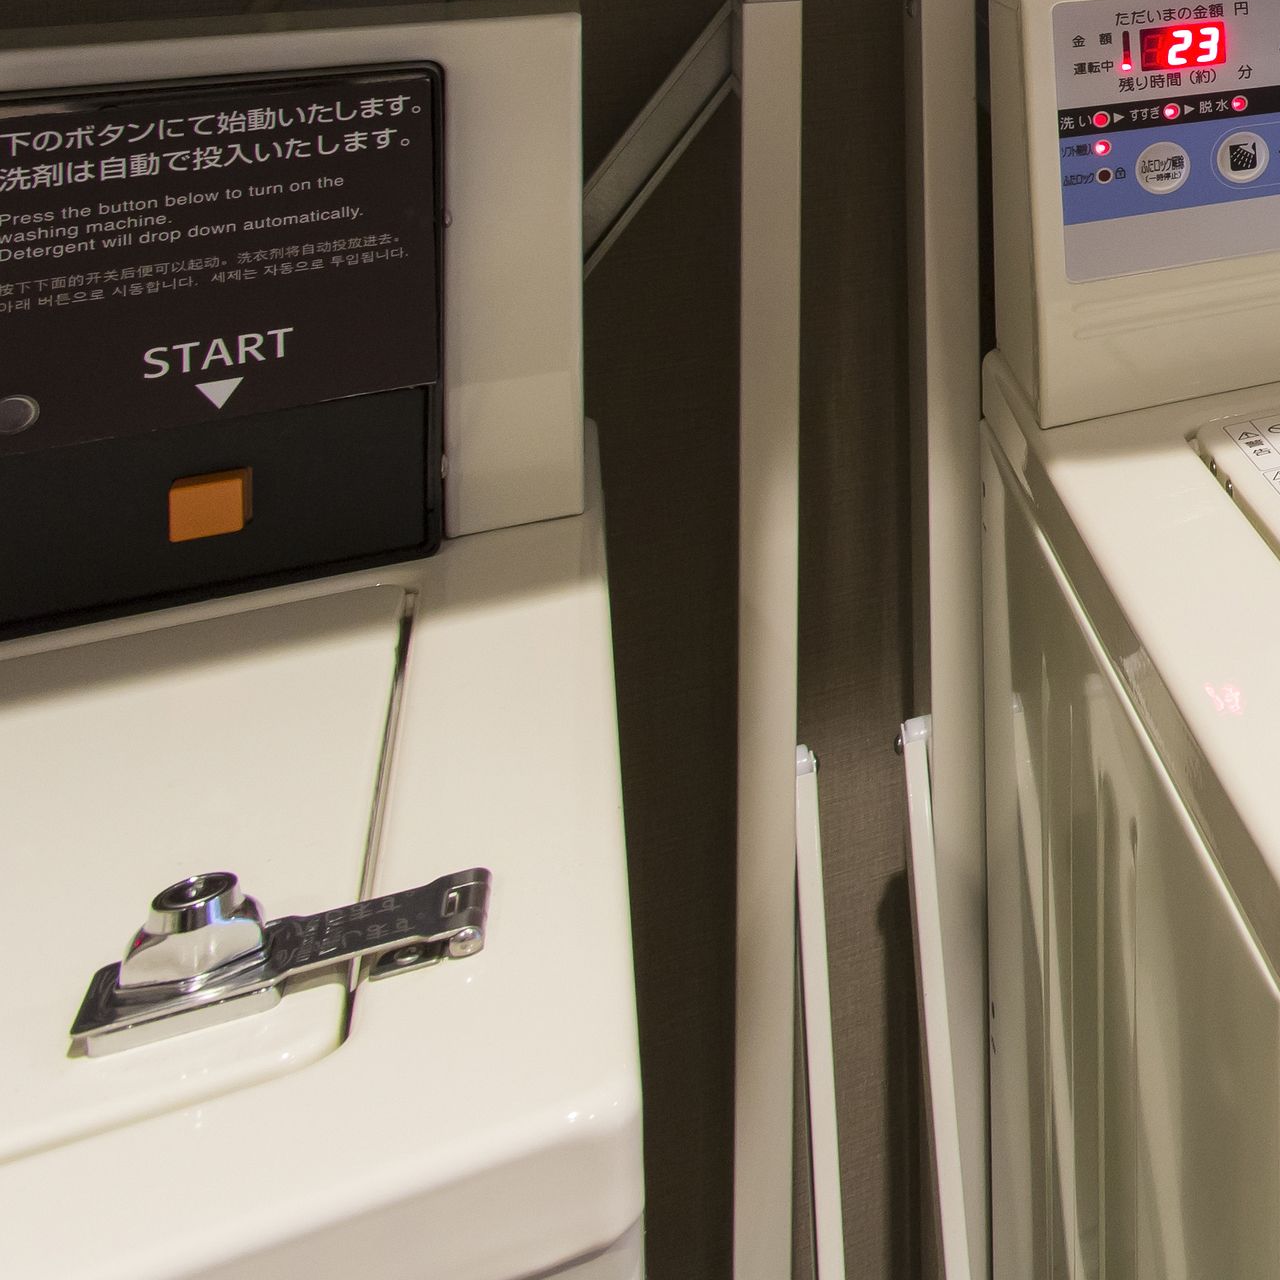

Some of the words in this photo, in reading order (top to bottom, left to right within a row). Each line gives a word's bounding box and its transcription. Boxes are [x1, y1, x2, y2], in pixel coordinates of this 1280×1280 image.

[1115, 4, 1224, 26] ただいまの金額
[1074, 60, 1114, 76] 運転中
[1167, 26, 1220, 66] 23
[0, 94, 422, 158] 下のボタンにて始動いたします。
[1129, 106, 1160, 121] すすぎ
[0, 127, 412, 192] 洗剤は自動で投入いたします。
[0, 210, 55, 227] Press
[62, 207, 92, 220] the
[99, 198, 158, 215] button
[165, 192, 219, 208] below
[225, 189, 242, 200] to
[250, 185, 283, 197] turn
[290, 181, 311, 192] on
[317, 177, 344, 189] the
[0, 227, 79, 245] washing
[86, 215, 172, 233] machine.
[0, 239, 96, 263] Detergent
[102, 233, 133, 248] will
[139, 230, 182, 245] drop
[188, 222, 237, 238] down
[243, 206, 364, 232] automatically.
[143, 327, 294, 379] START
